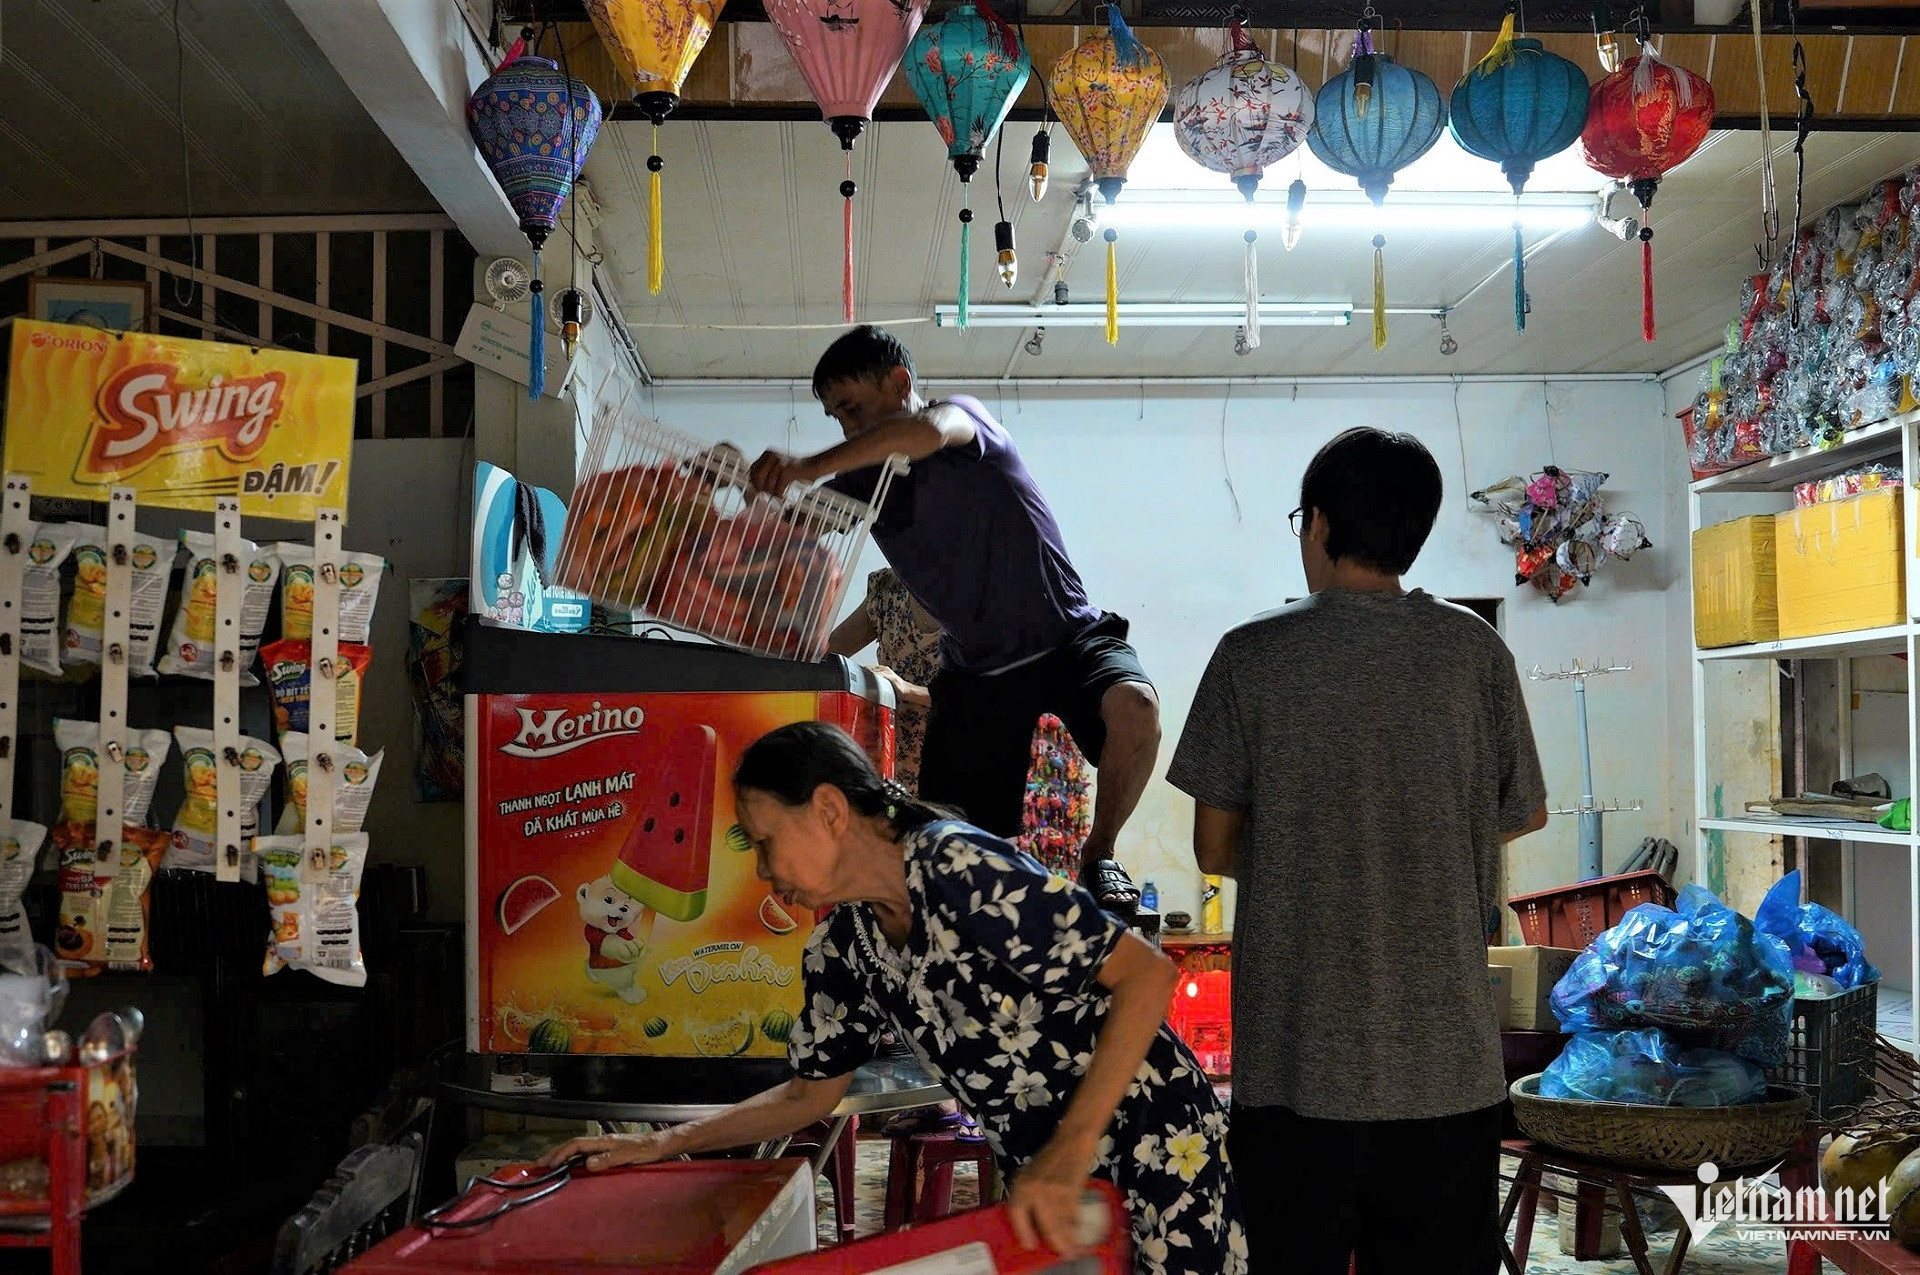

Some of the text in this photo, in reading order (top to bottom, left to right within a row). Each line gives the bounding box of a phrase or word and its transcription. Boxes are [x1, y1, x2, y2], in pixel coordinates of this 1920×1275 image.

[52, 338, 107, 354] ORION
[106, 374, 277, 456] Swing
[243, 461, 341, 499] ĐẬM!
[512, 700, 645, 748] Merino
[498, 771, 636, 816] THANH NGỌT LẠNH MÁT
[545, 808, 579, 832] KHÁT
[581, 807, 605, 824] MÙA
[607, 801, 623, 818] HÈ
[693, 942, 742, 957] WATERMELON
